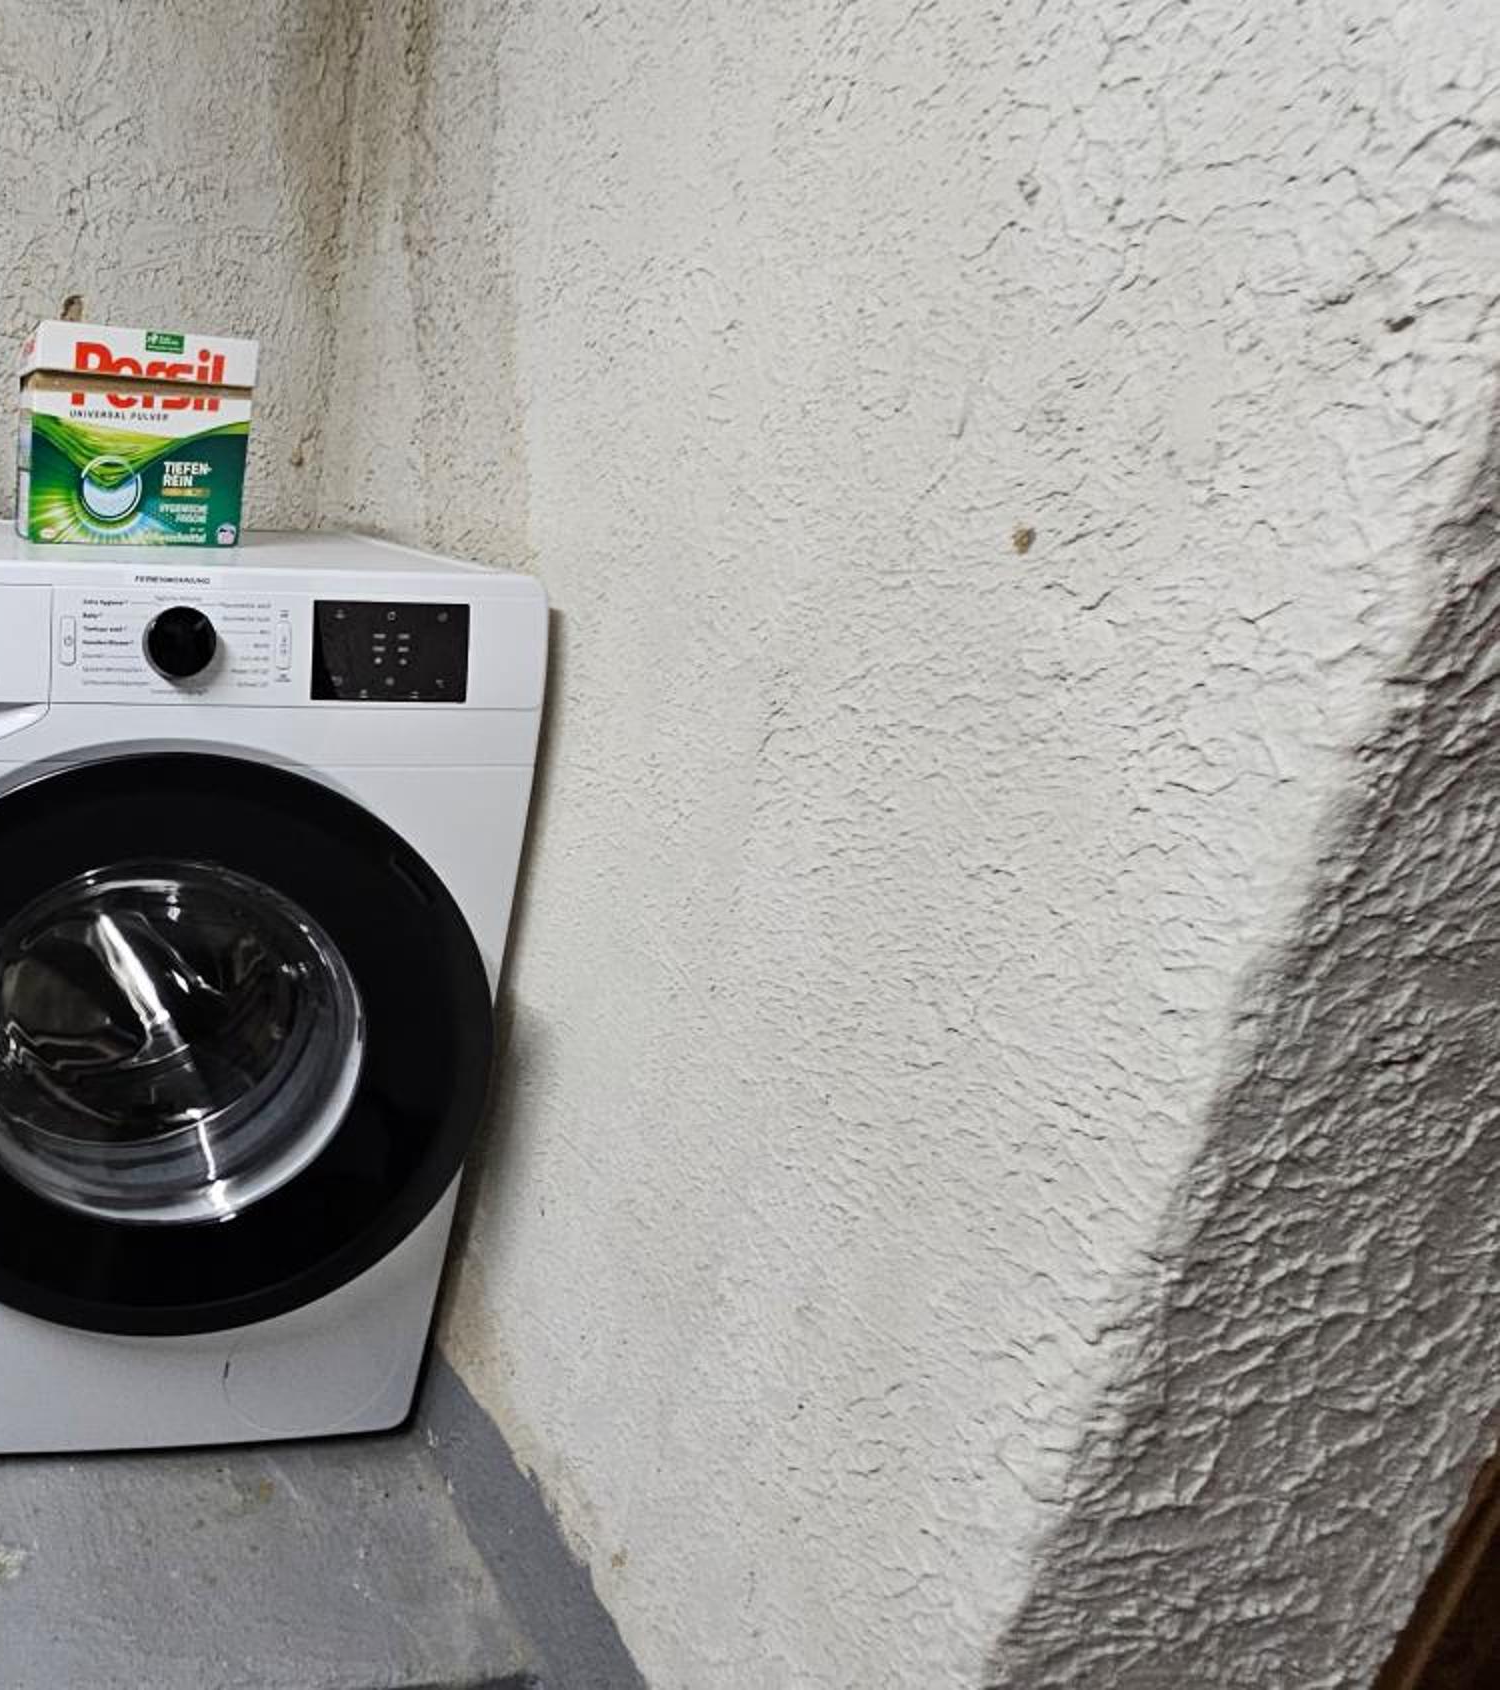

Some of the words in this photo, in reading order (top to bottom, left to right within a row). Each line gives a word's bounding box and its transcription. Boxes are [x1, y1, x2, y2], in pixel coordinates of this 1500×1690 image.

[69, 409, 126, 421] UNIVERSAL
[130, 412, 169, 421] PULVER
[163, 461, 213, 475] TIEFEN-
[163, 475, 193, 487] REIN
